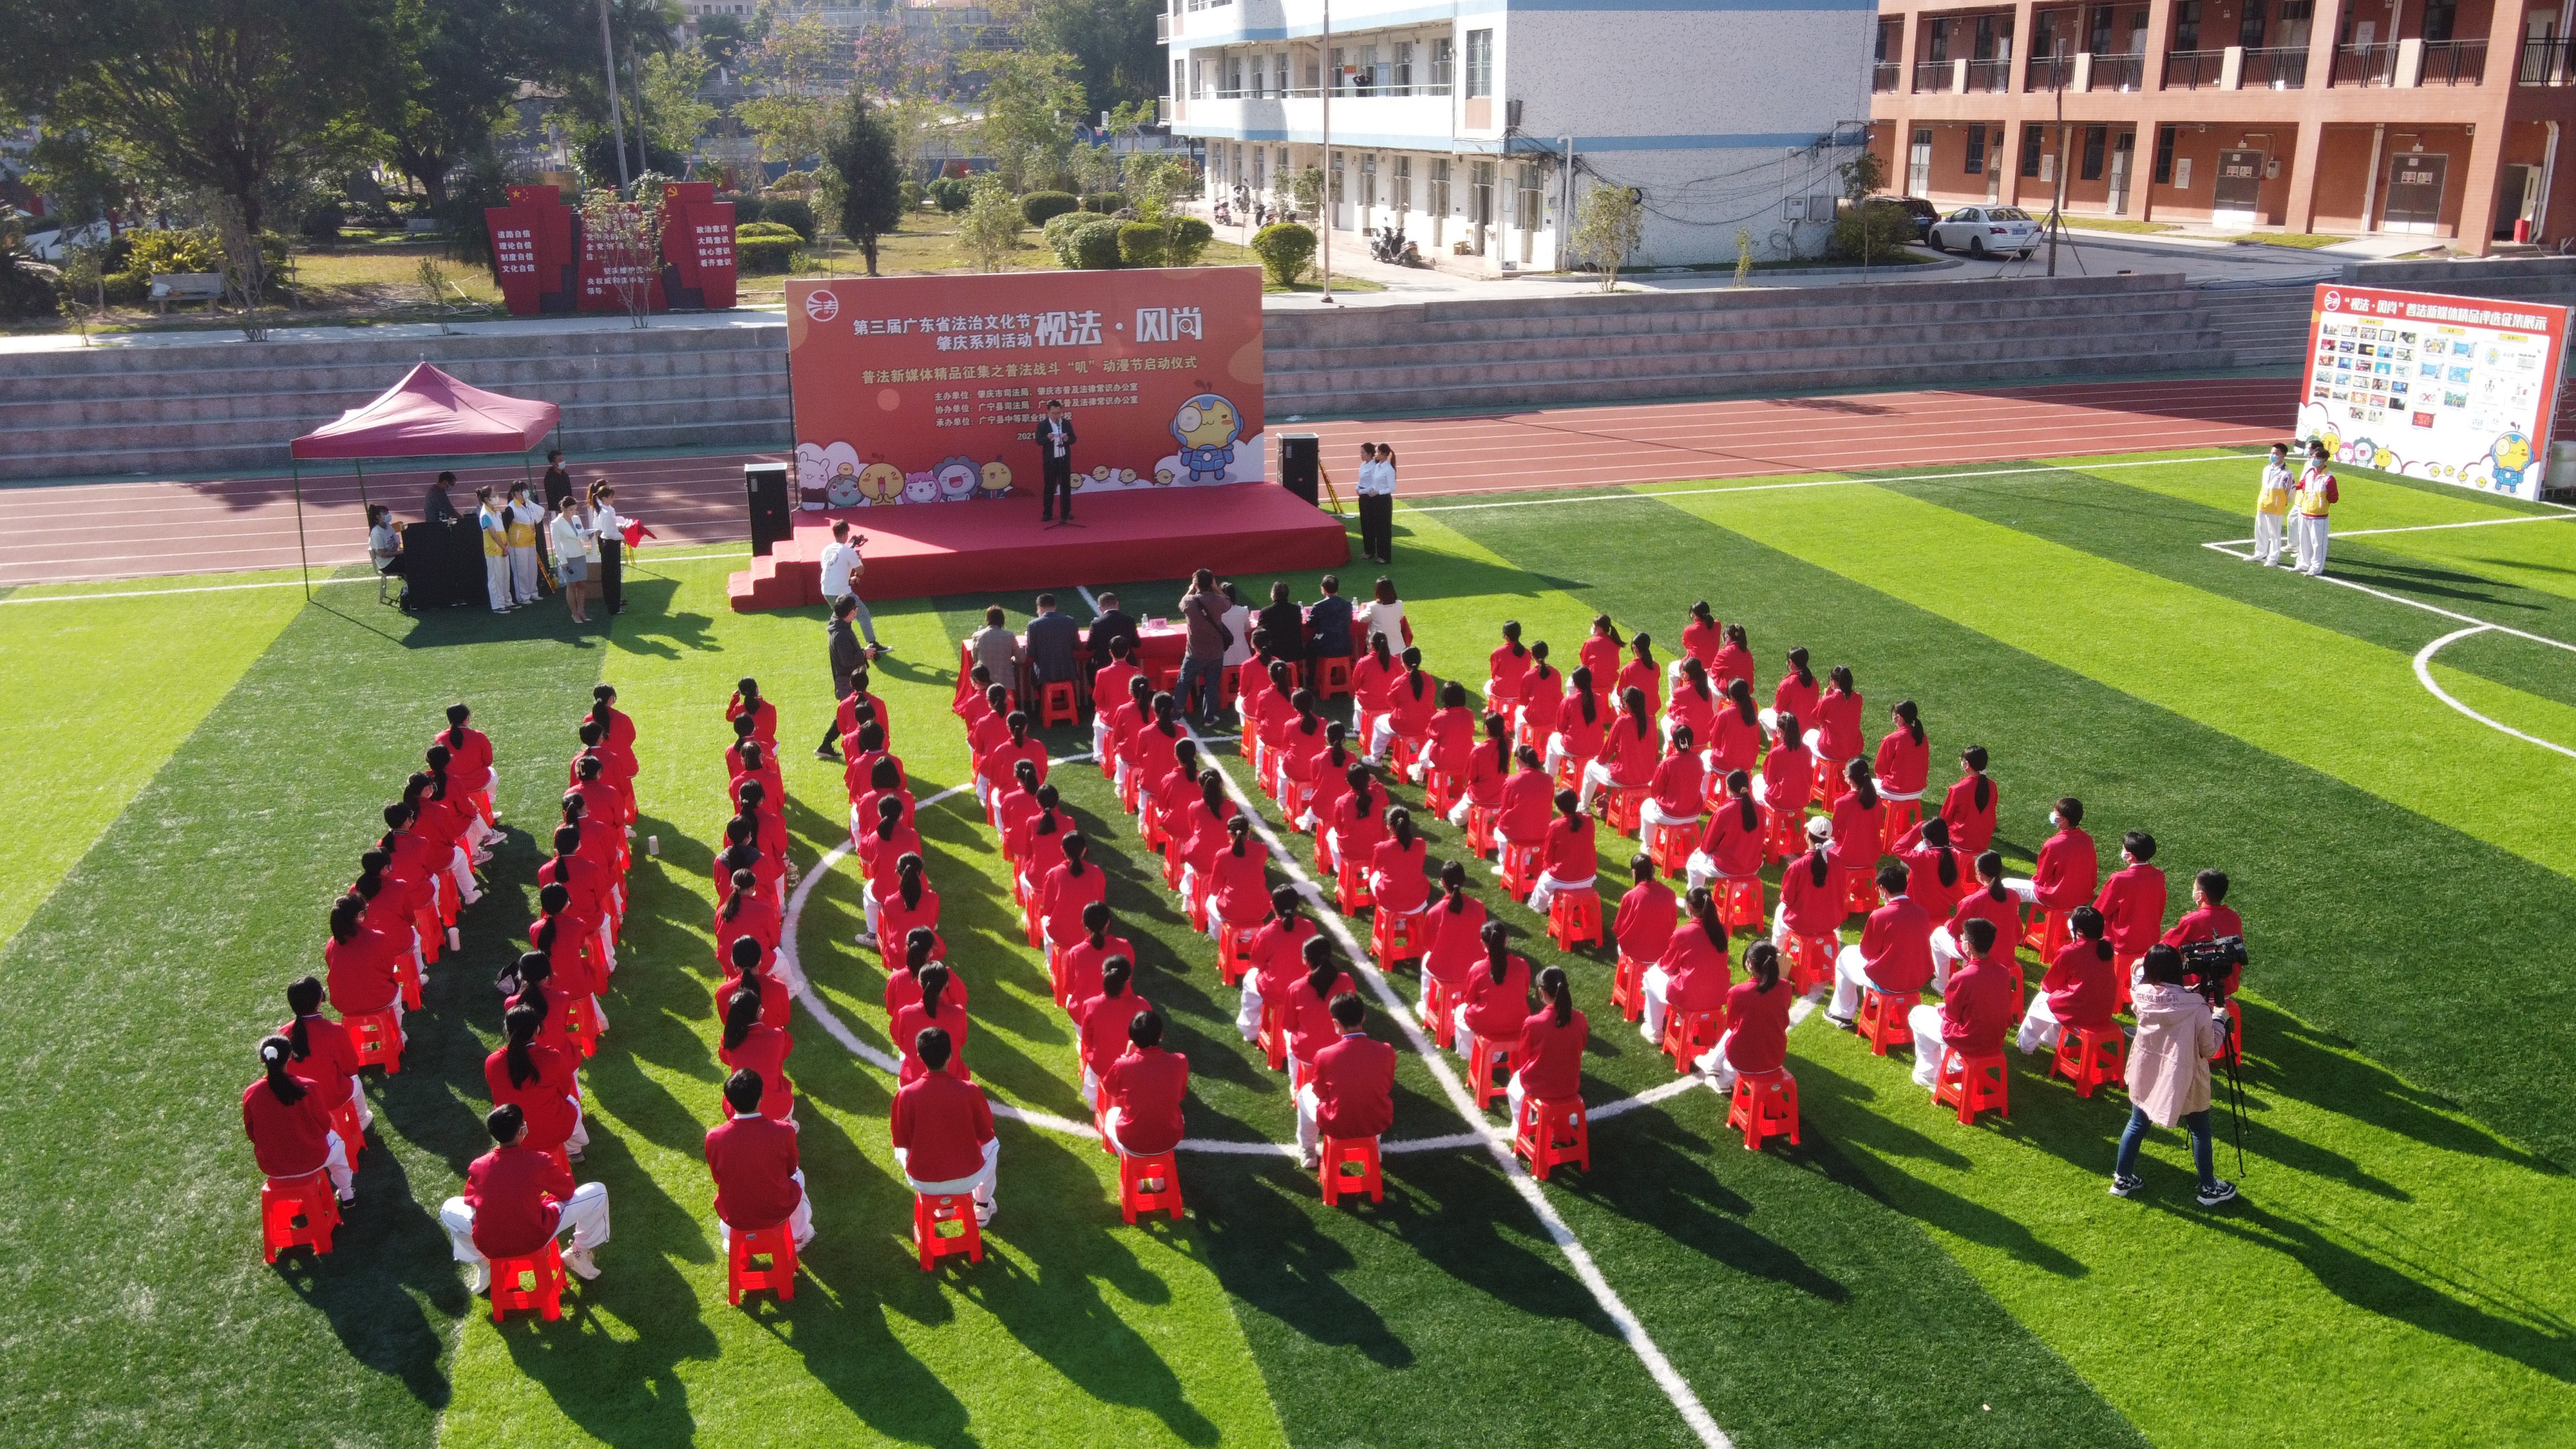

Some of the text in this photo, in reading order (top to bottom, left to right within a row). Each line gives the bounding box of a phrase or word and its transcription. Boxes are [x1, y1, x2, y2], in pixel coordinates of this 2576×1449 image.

[497, 229, 531, 239] 道路自信
[696, 224, 728, 234] 政治意识
[697, 235, 730, 245] 大局意识
[498, 241, 533, 250] 理论自信
[500, 252, 534, 261] 制度自信
[698, 247, 731, 256] 核心意识
[700, 258, 732, 267] 看齐意识
[502, 263, 536, 273] 文化自信
[853, 312, 1032, 336] 第三届广东省法治文化节
[1034, 306, 1203, 347] 视法·风尚
[936, 332, 1033, 352] 肇庆系列活动
